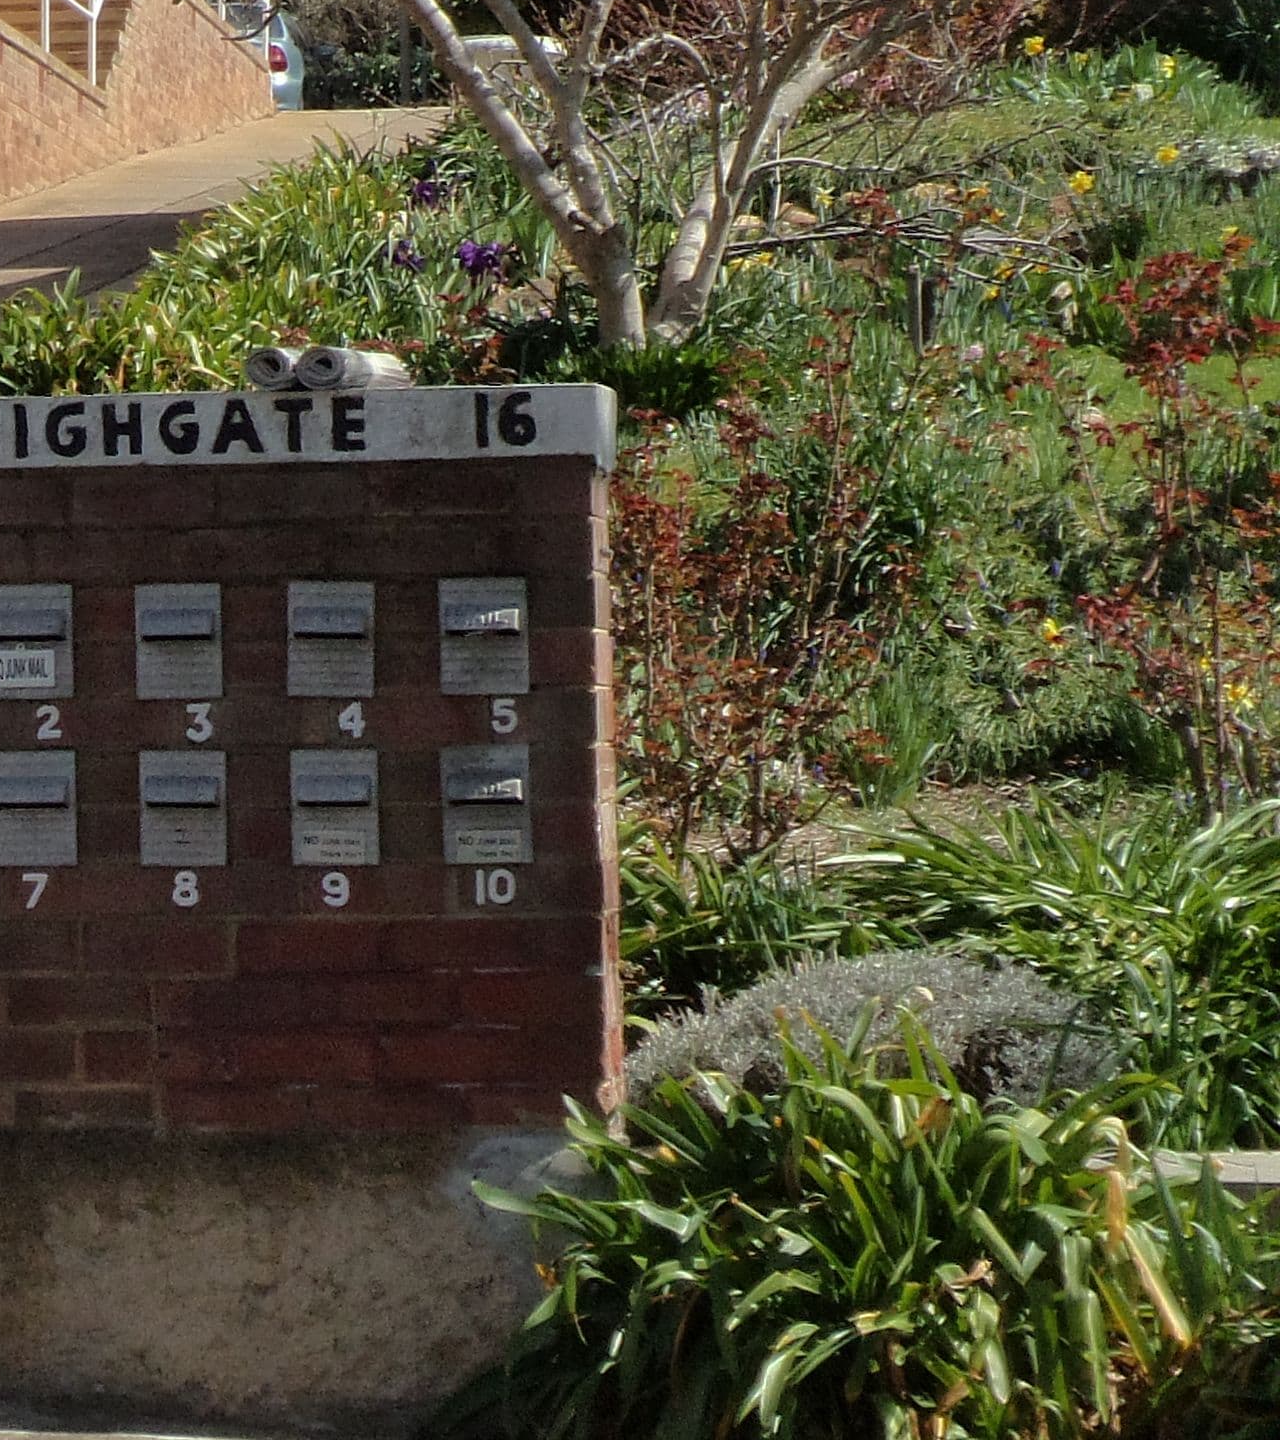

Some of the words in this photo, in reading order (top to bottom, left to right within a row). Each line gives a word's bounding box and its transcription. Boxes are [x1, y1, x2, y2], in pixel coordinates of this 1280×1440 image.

[473, 391, 537, 450] 16
[5, 658, 27, 679] JUNK
[35, 704, 63, 740] 2
[185, 702, 214, 743] 3
[337, 701, 366, 739] 4
[491, 698, 519, 734] 5
[21, 871, 49, 909] 7
[171, 870, 200, 907] 8
[321, 871, 350, 907] 9
[475, 868, 517, 906] 10
